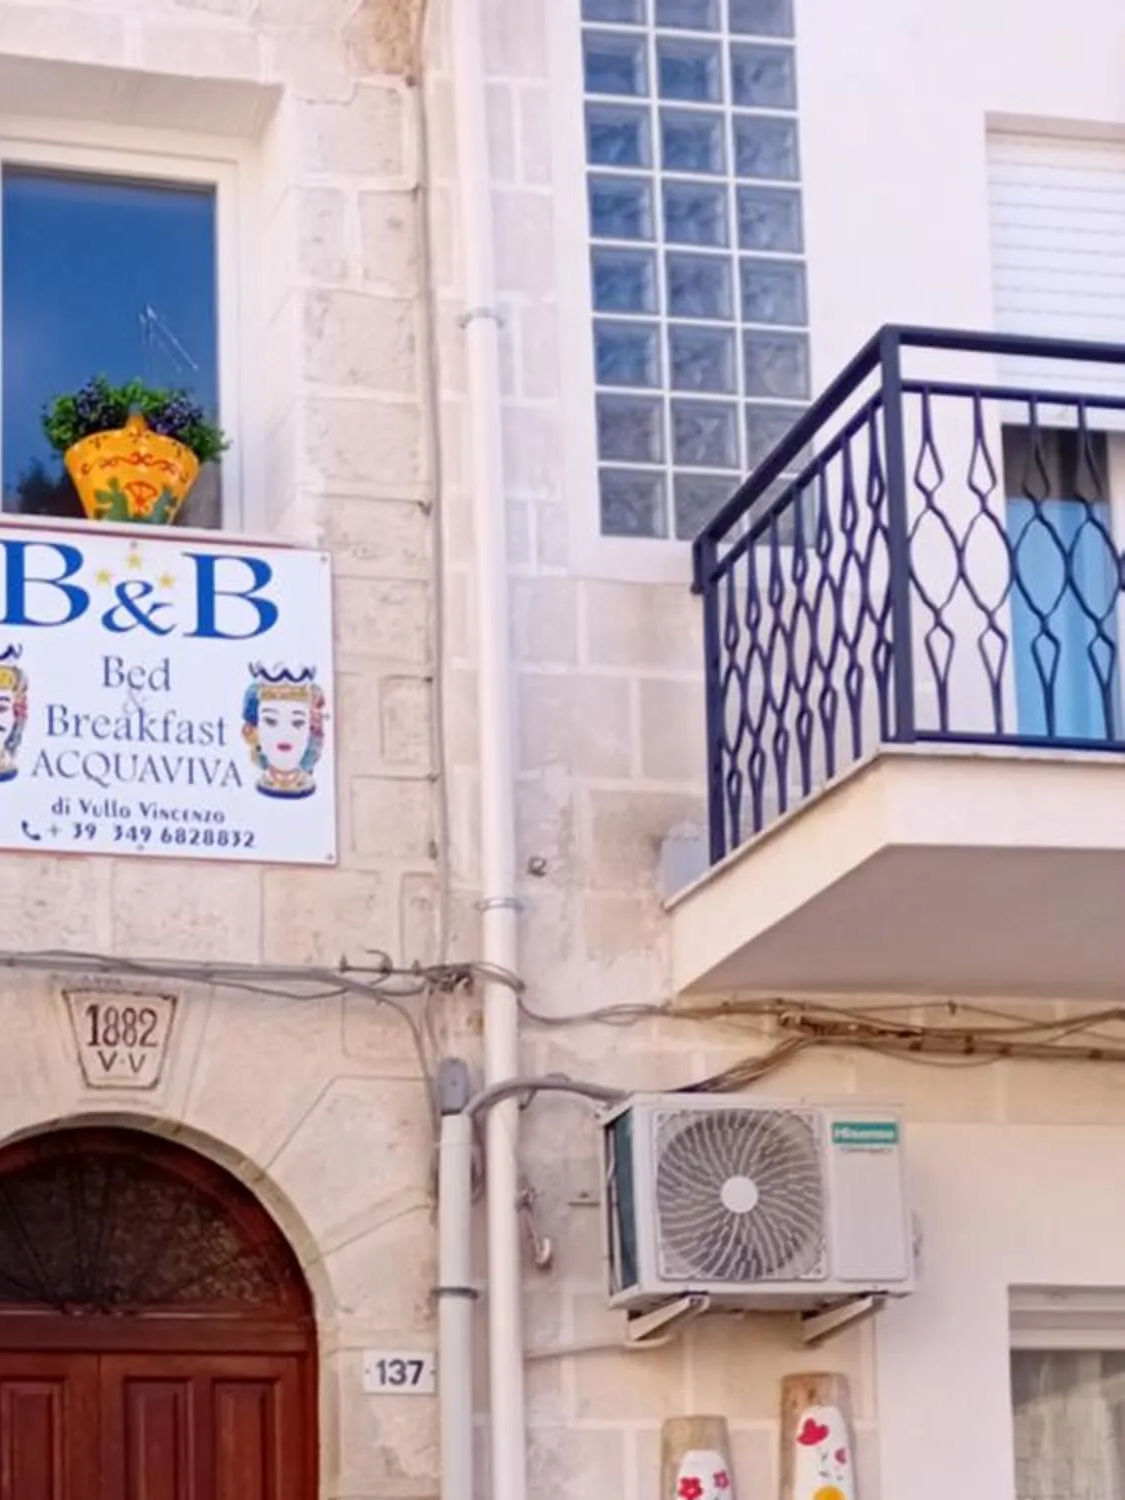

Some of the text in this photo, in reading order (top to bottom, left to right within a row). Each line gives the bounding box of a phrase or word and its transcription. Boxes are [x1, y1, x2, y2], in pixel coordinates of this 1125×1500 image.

[101, 654, 172, 692] Bed
[45, 703, 226, 747] Breakfast
[30, 748, 244, 788] ACQUAVIVA
[51, 796, 71, 815] di
[78, 798, 131, 819] Vullo
[73, 822, 98, 841] 39
[113, 824, 152, 842] 349
[160, 828, 257, 849] 6828832
[85, 1003, 159, 1048] 1882
[375, 1358, 425, 1386] 137
